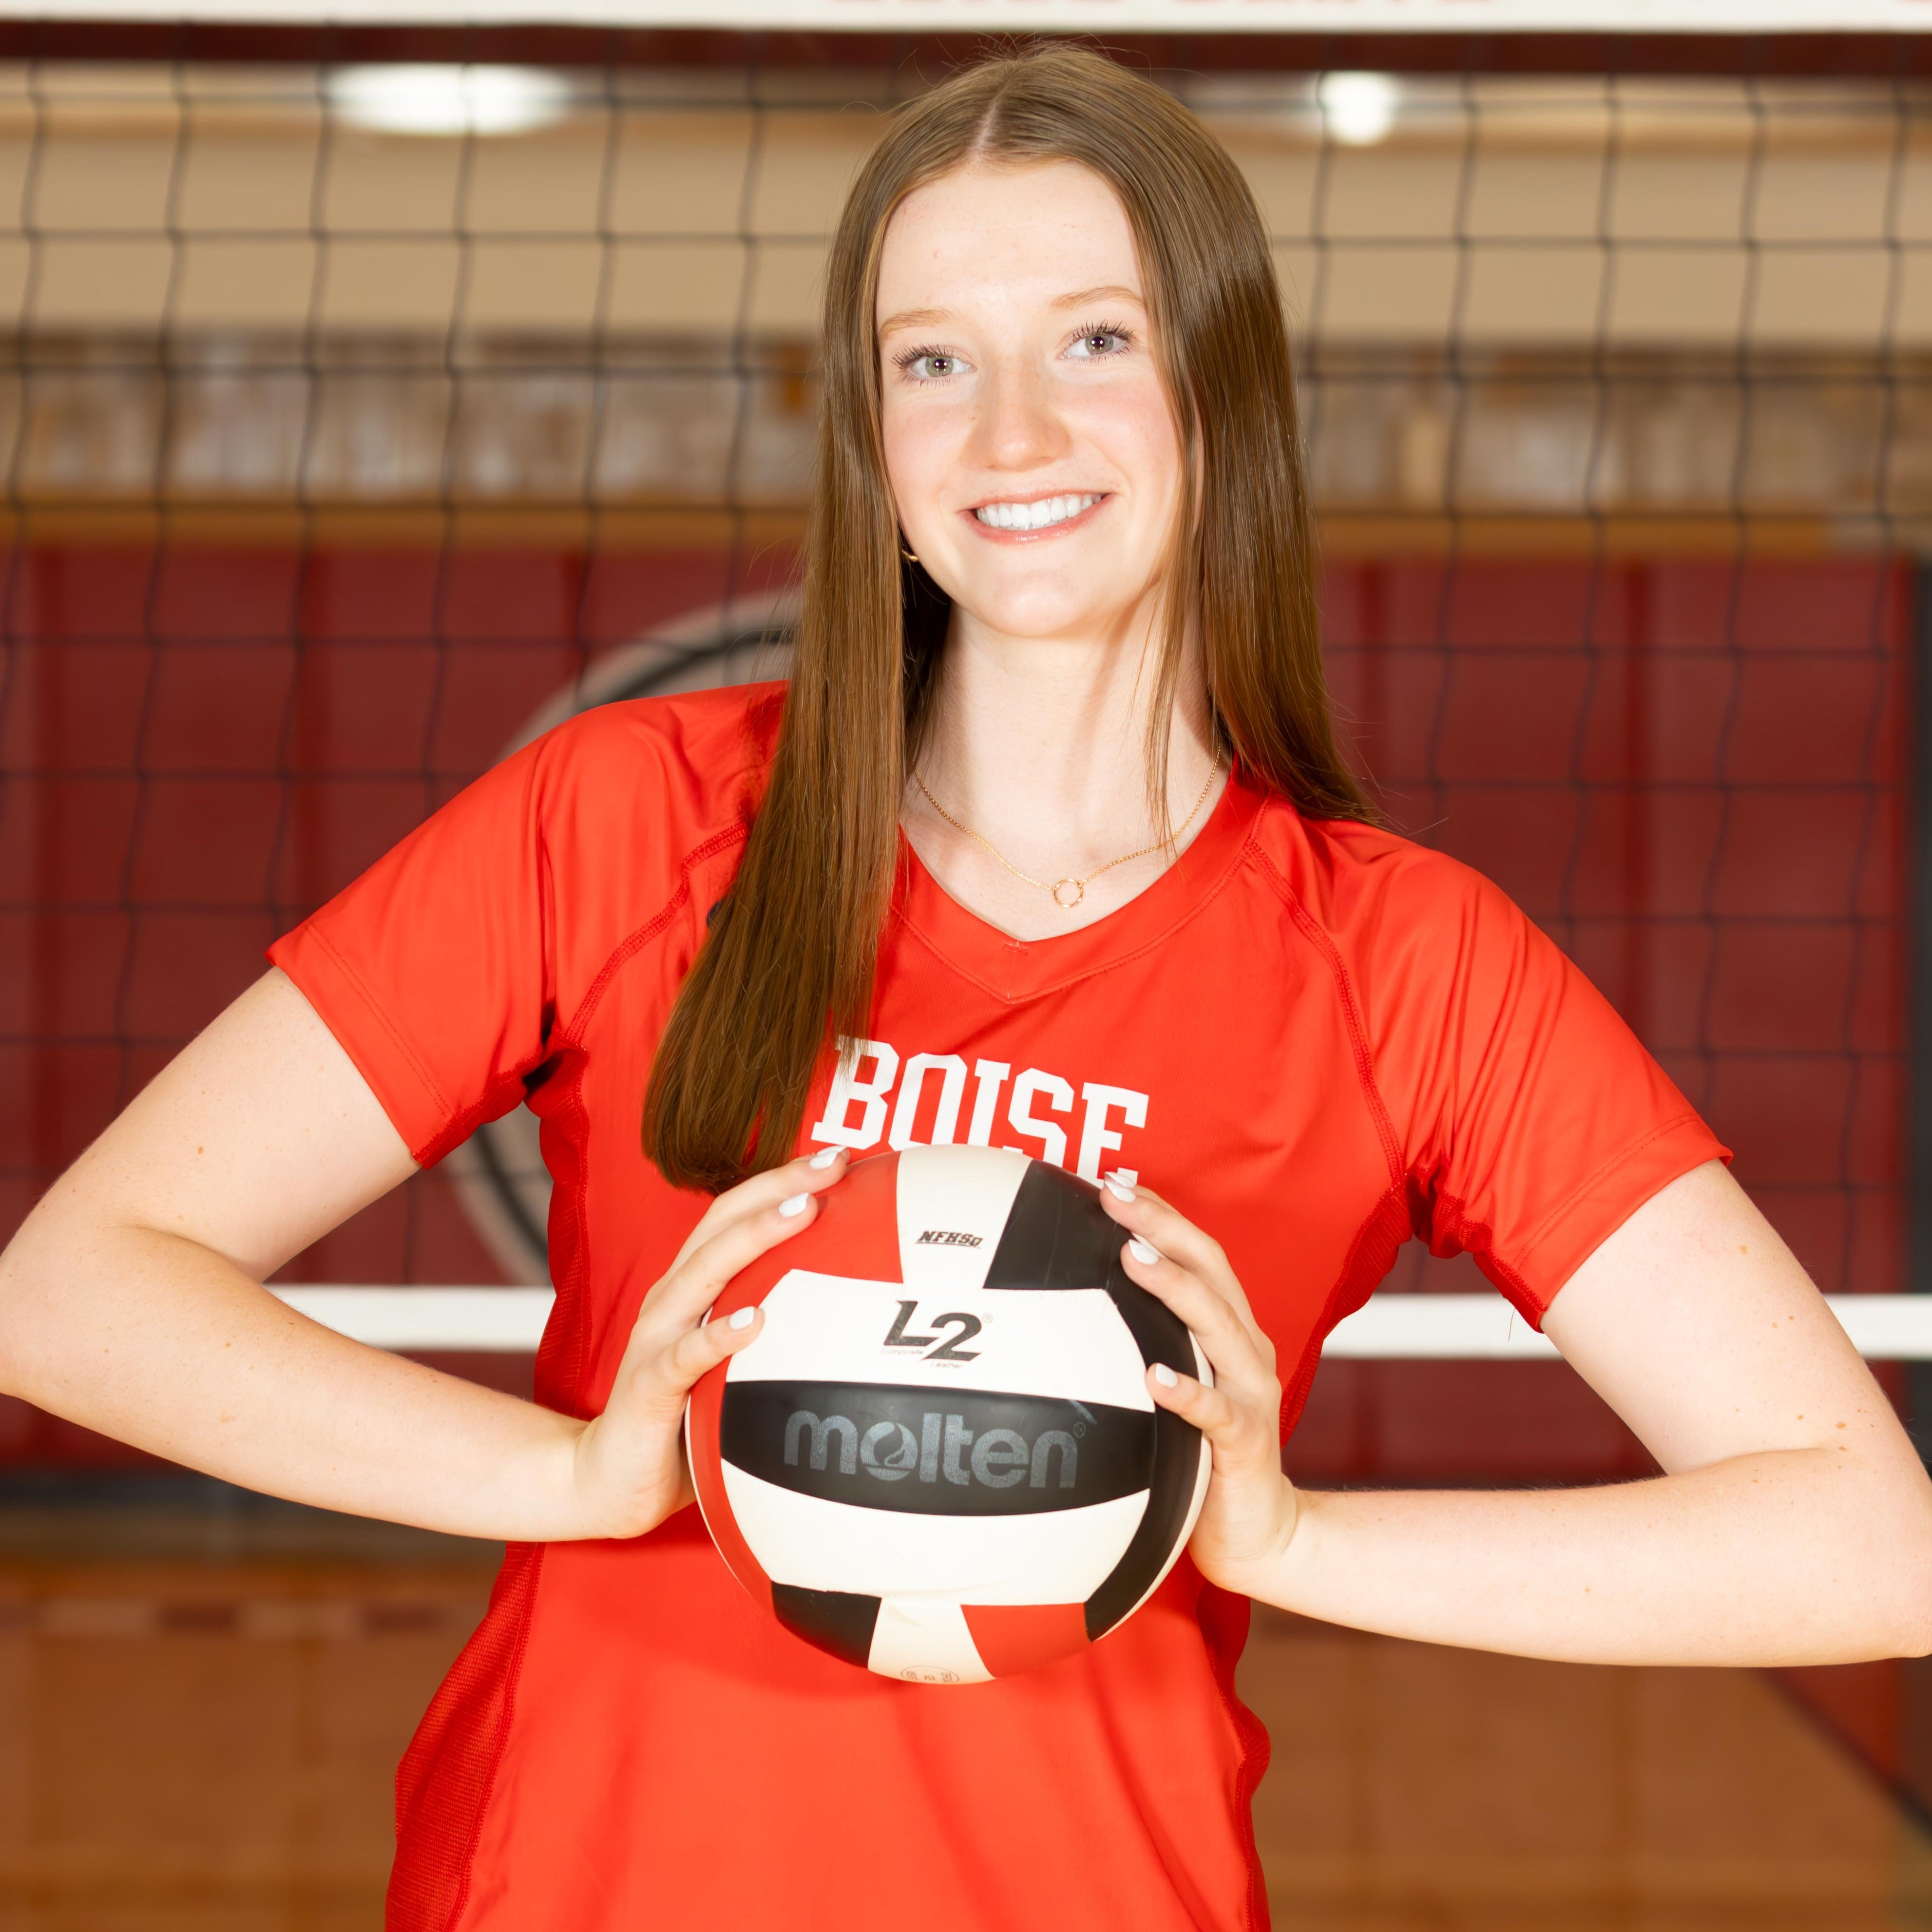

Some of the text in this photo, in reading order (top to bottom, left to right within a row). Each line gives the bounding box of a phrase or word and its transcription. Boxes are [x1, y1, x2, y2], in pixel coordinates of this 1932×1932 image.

[811, 1034, 1150, 1190] BOISE
[883, 1300, 982, 1361] L2
[784, 1410, 1078, 1489] molten
